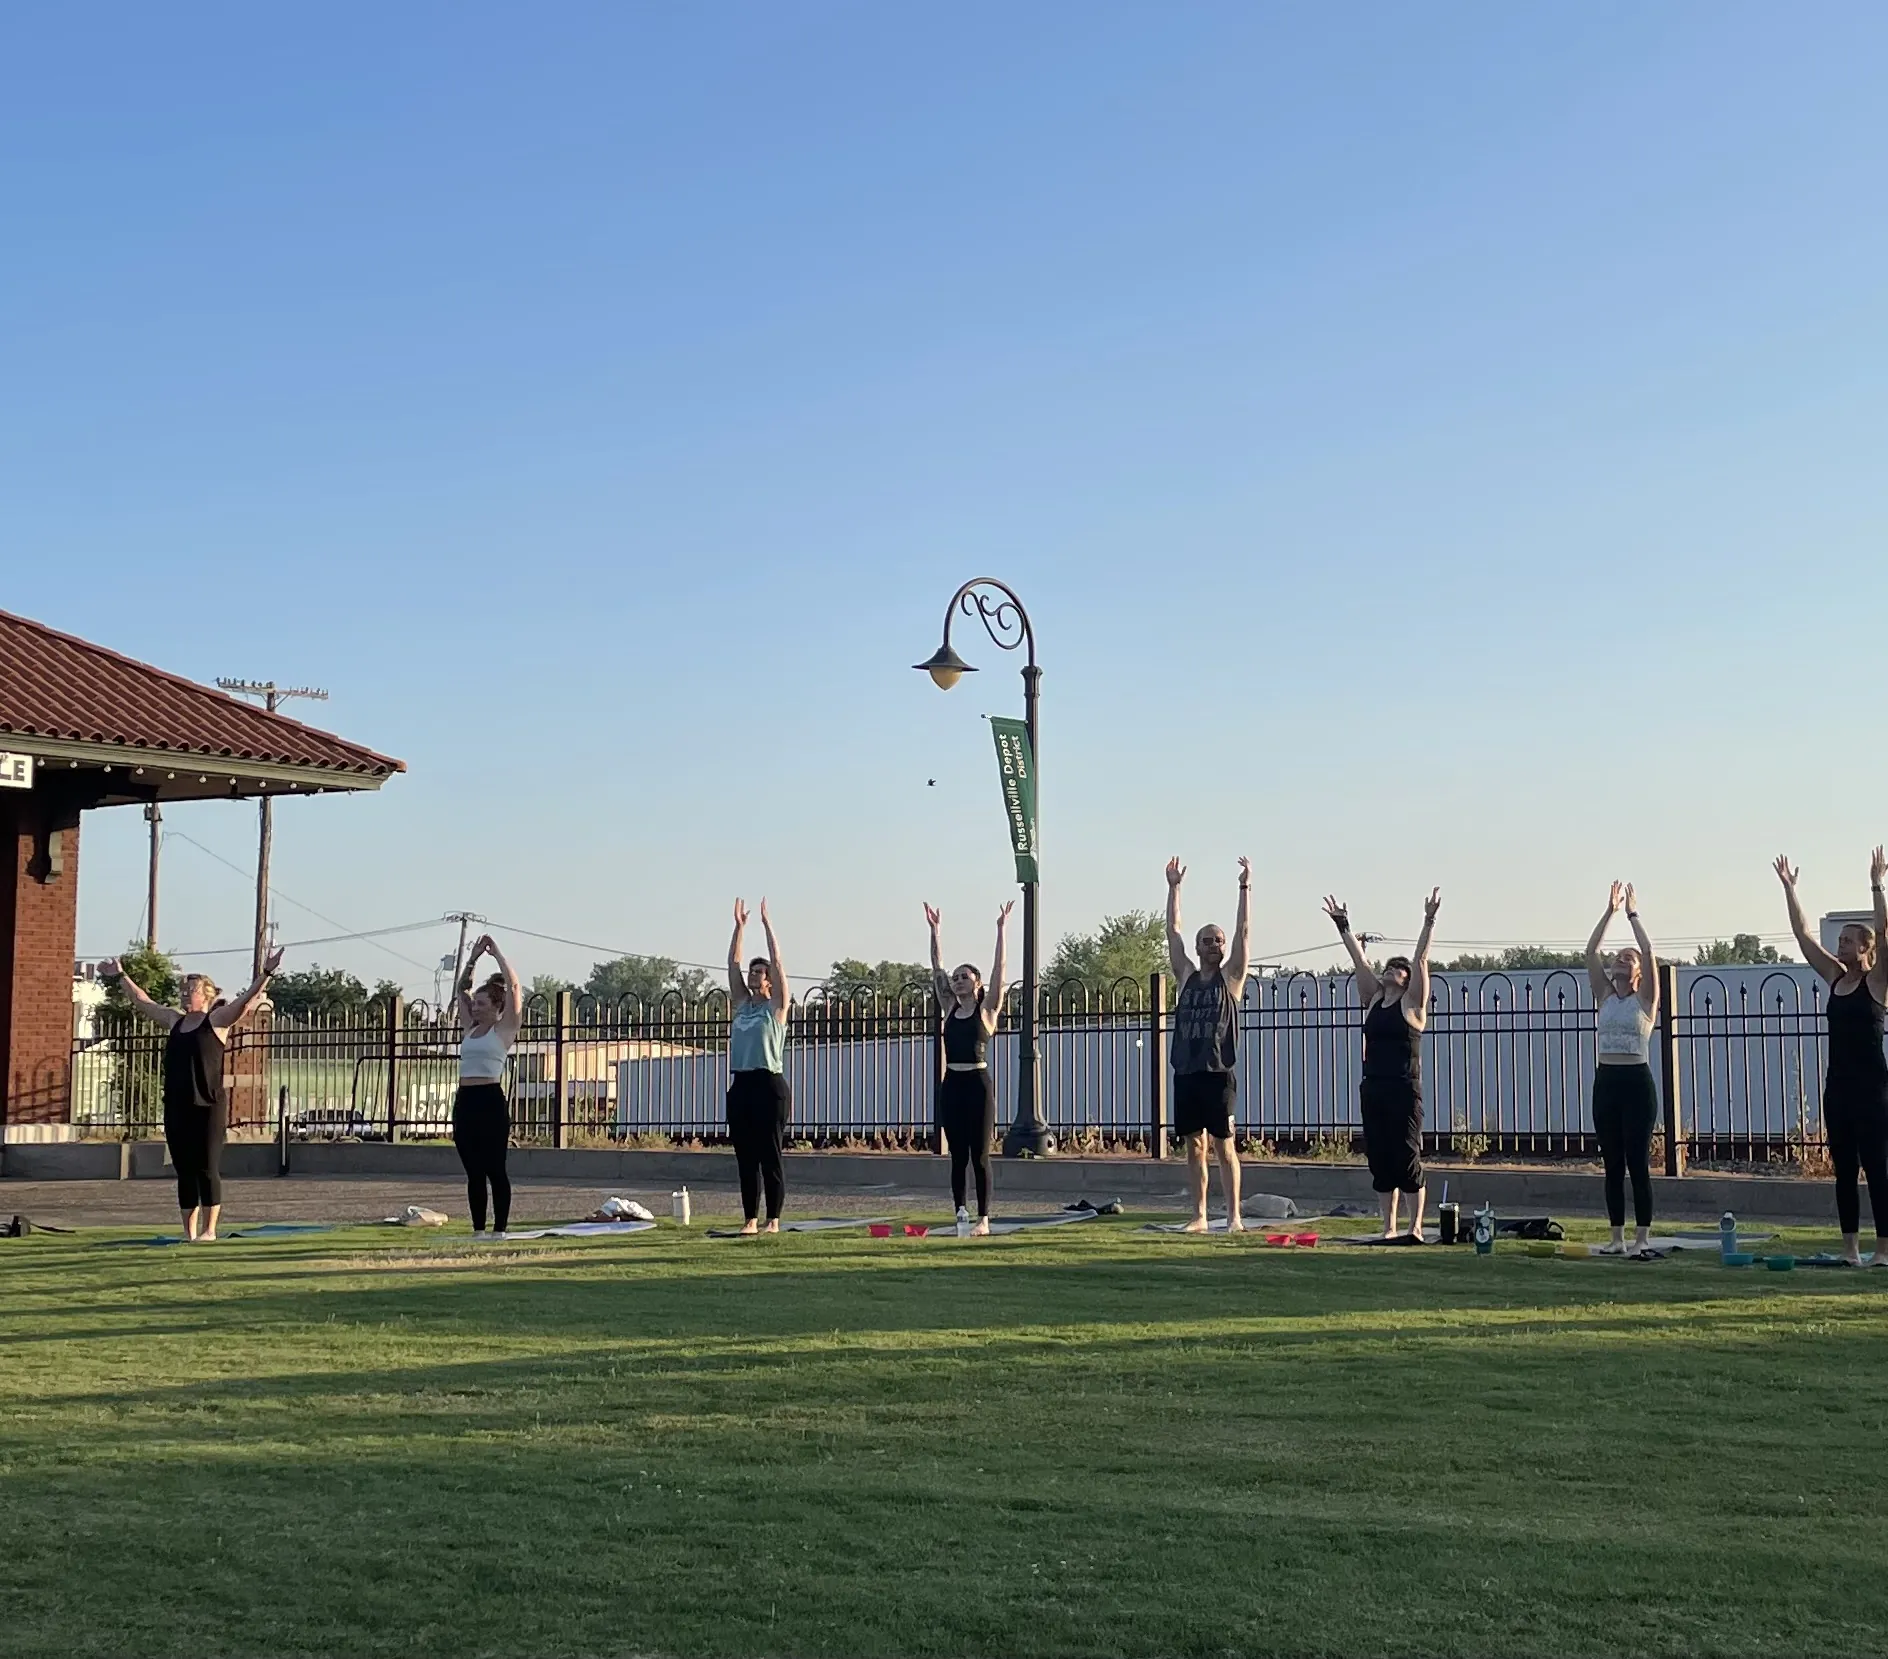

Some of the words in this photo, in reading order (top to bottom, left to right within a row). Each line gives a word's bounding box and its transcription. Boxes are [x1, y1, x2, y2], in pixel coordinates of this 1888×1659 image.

[999, 734, 1014, 775] Depot
[1011, 735, 1027, 779] District
[1007, 778, 1028, 851] Russellville
